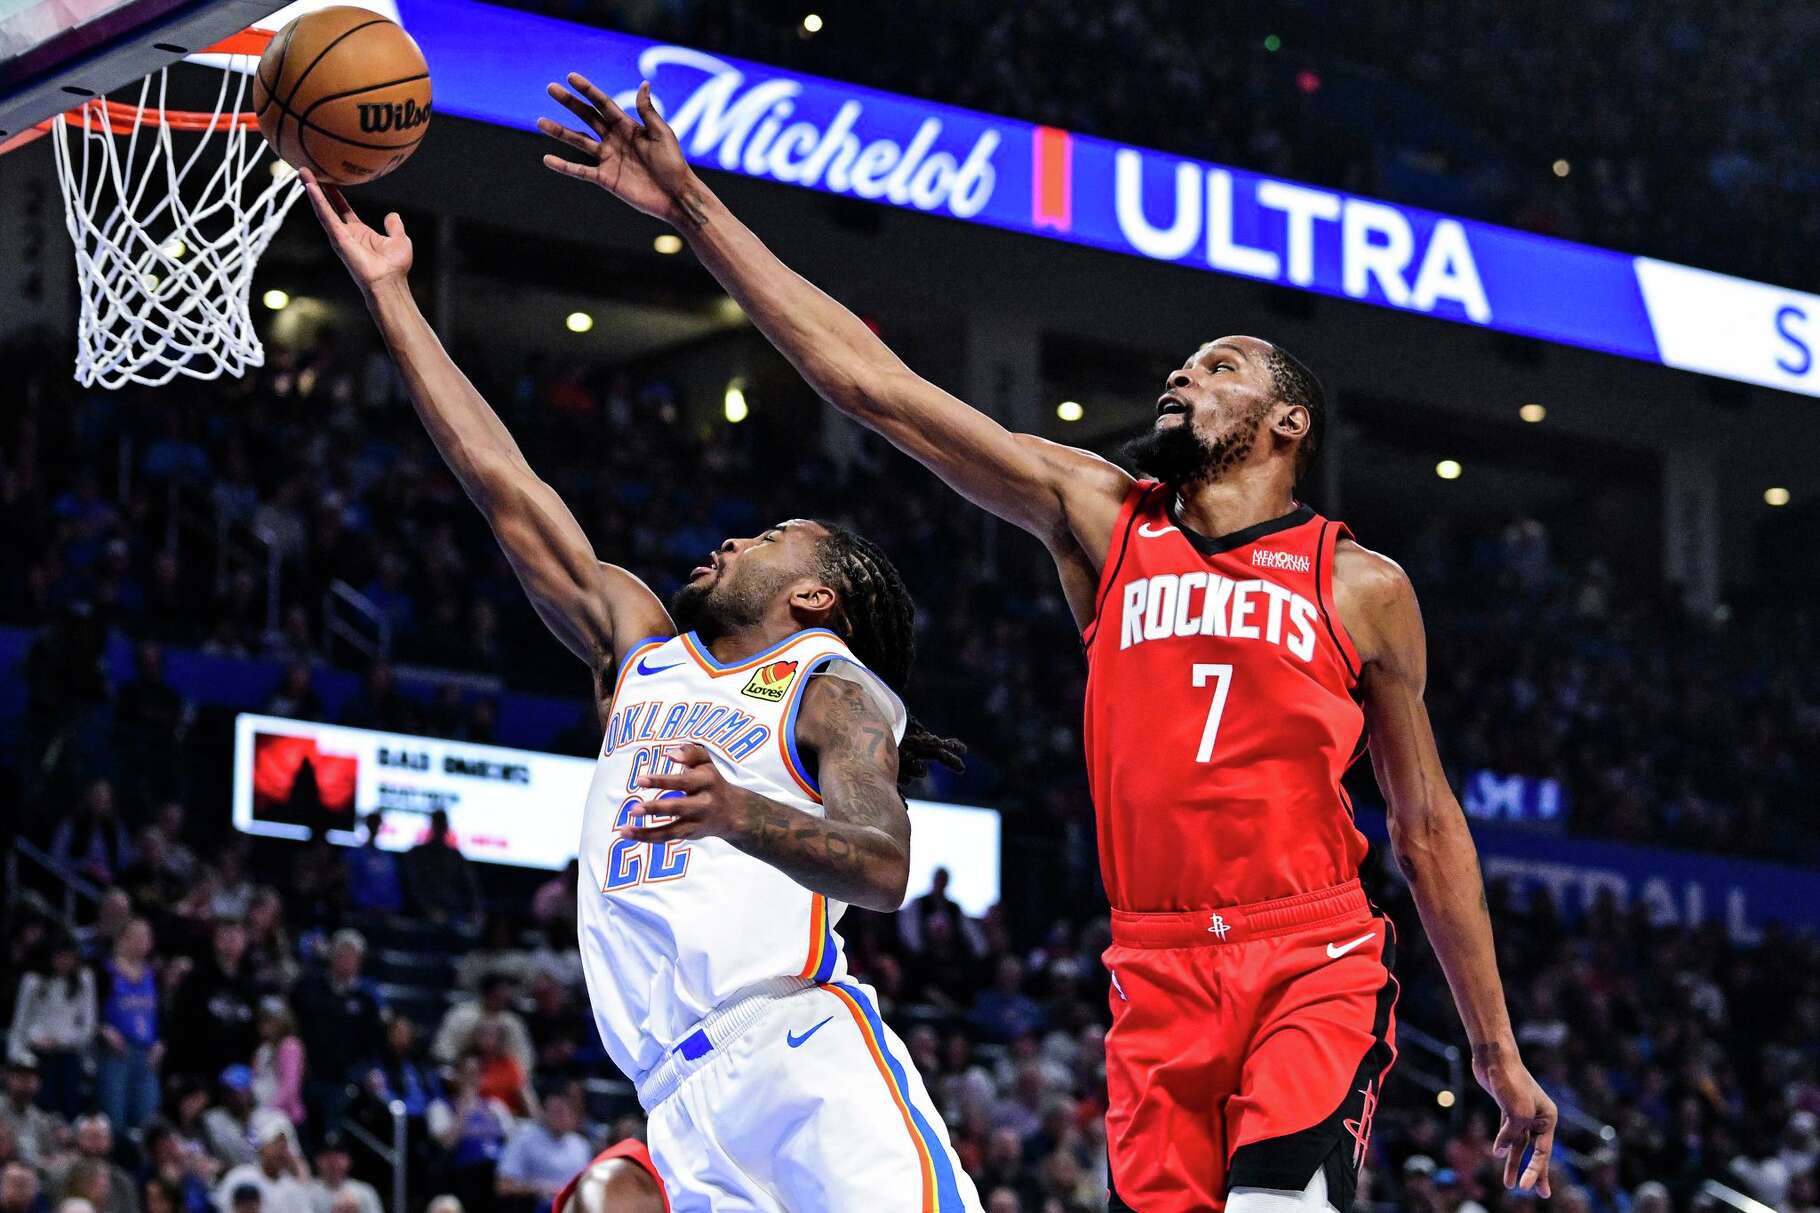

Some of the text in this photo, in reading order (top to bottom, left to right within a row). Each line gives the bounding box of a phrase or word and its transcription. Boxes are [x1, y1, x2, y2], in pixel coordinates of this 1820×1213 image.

[614, 46, 1492, 325] Michelob ULTRA
[1252, 549, 1309, 564] MEMORIAL
[1252, 557, 1310, 572] HERMANN
[1120, 571, 1318, 662] ROCKETS
[604, 701, 771, 764] OKLAHOMA
[1192, 664, 1233, 763] 7
[627, 743, 688, 794] CIT
